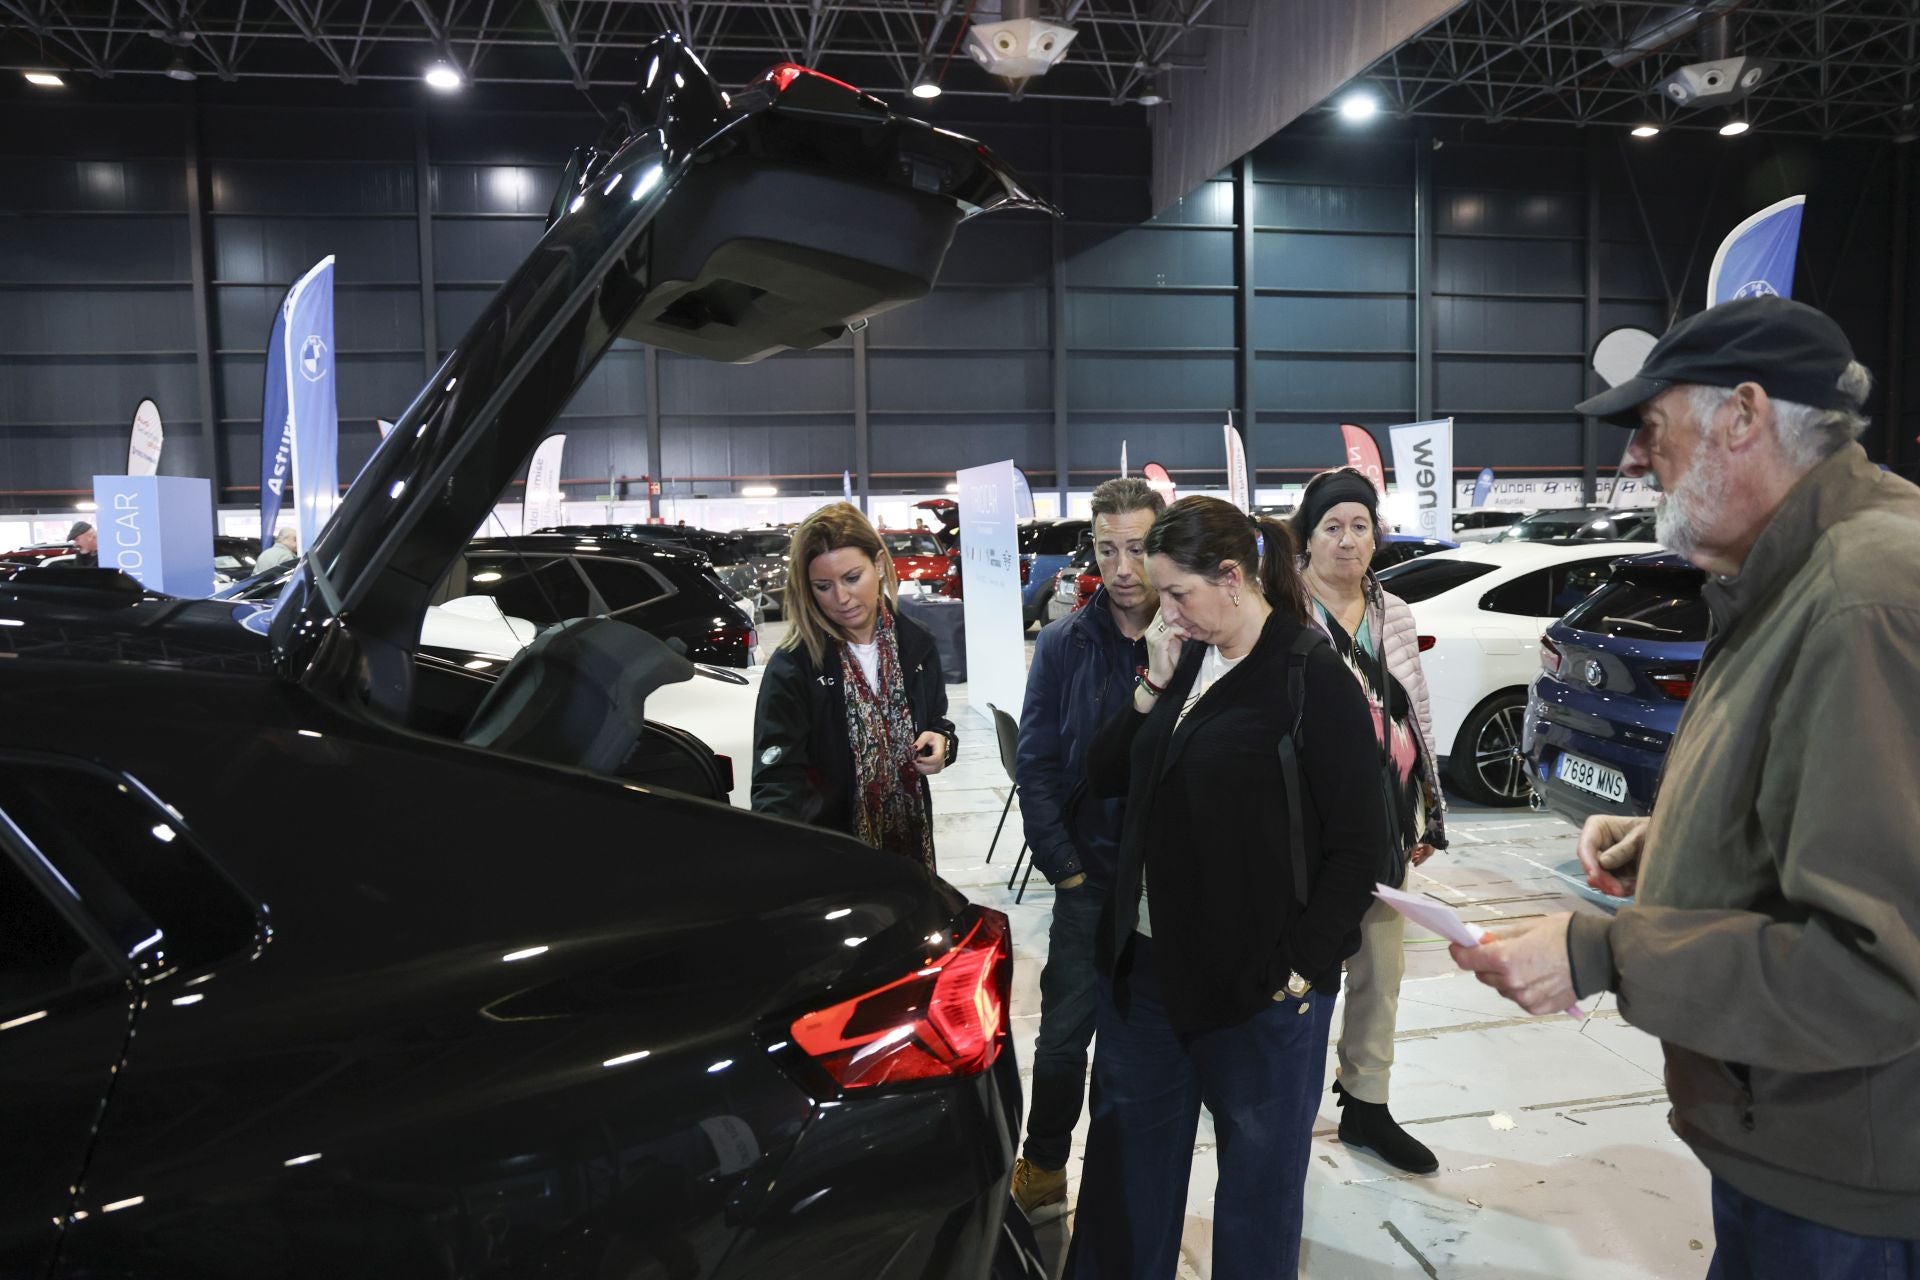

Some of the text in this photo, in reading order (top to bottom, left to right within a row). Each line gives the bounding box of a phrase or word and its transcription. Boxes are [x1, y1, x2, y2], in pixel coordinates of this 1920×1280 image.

[1489, 483, 1536, 493] YUNDAI
[1563, 758, 1623, 796] 7698 MNS
